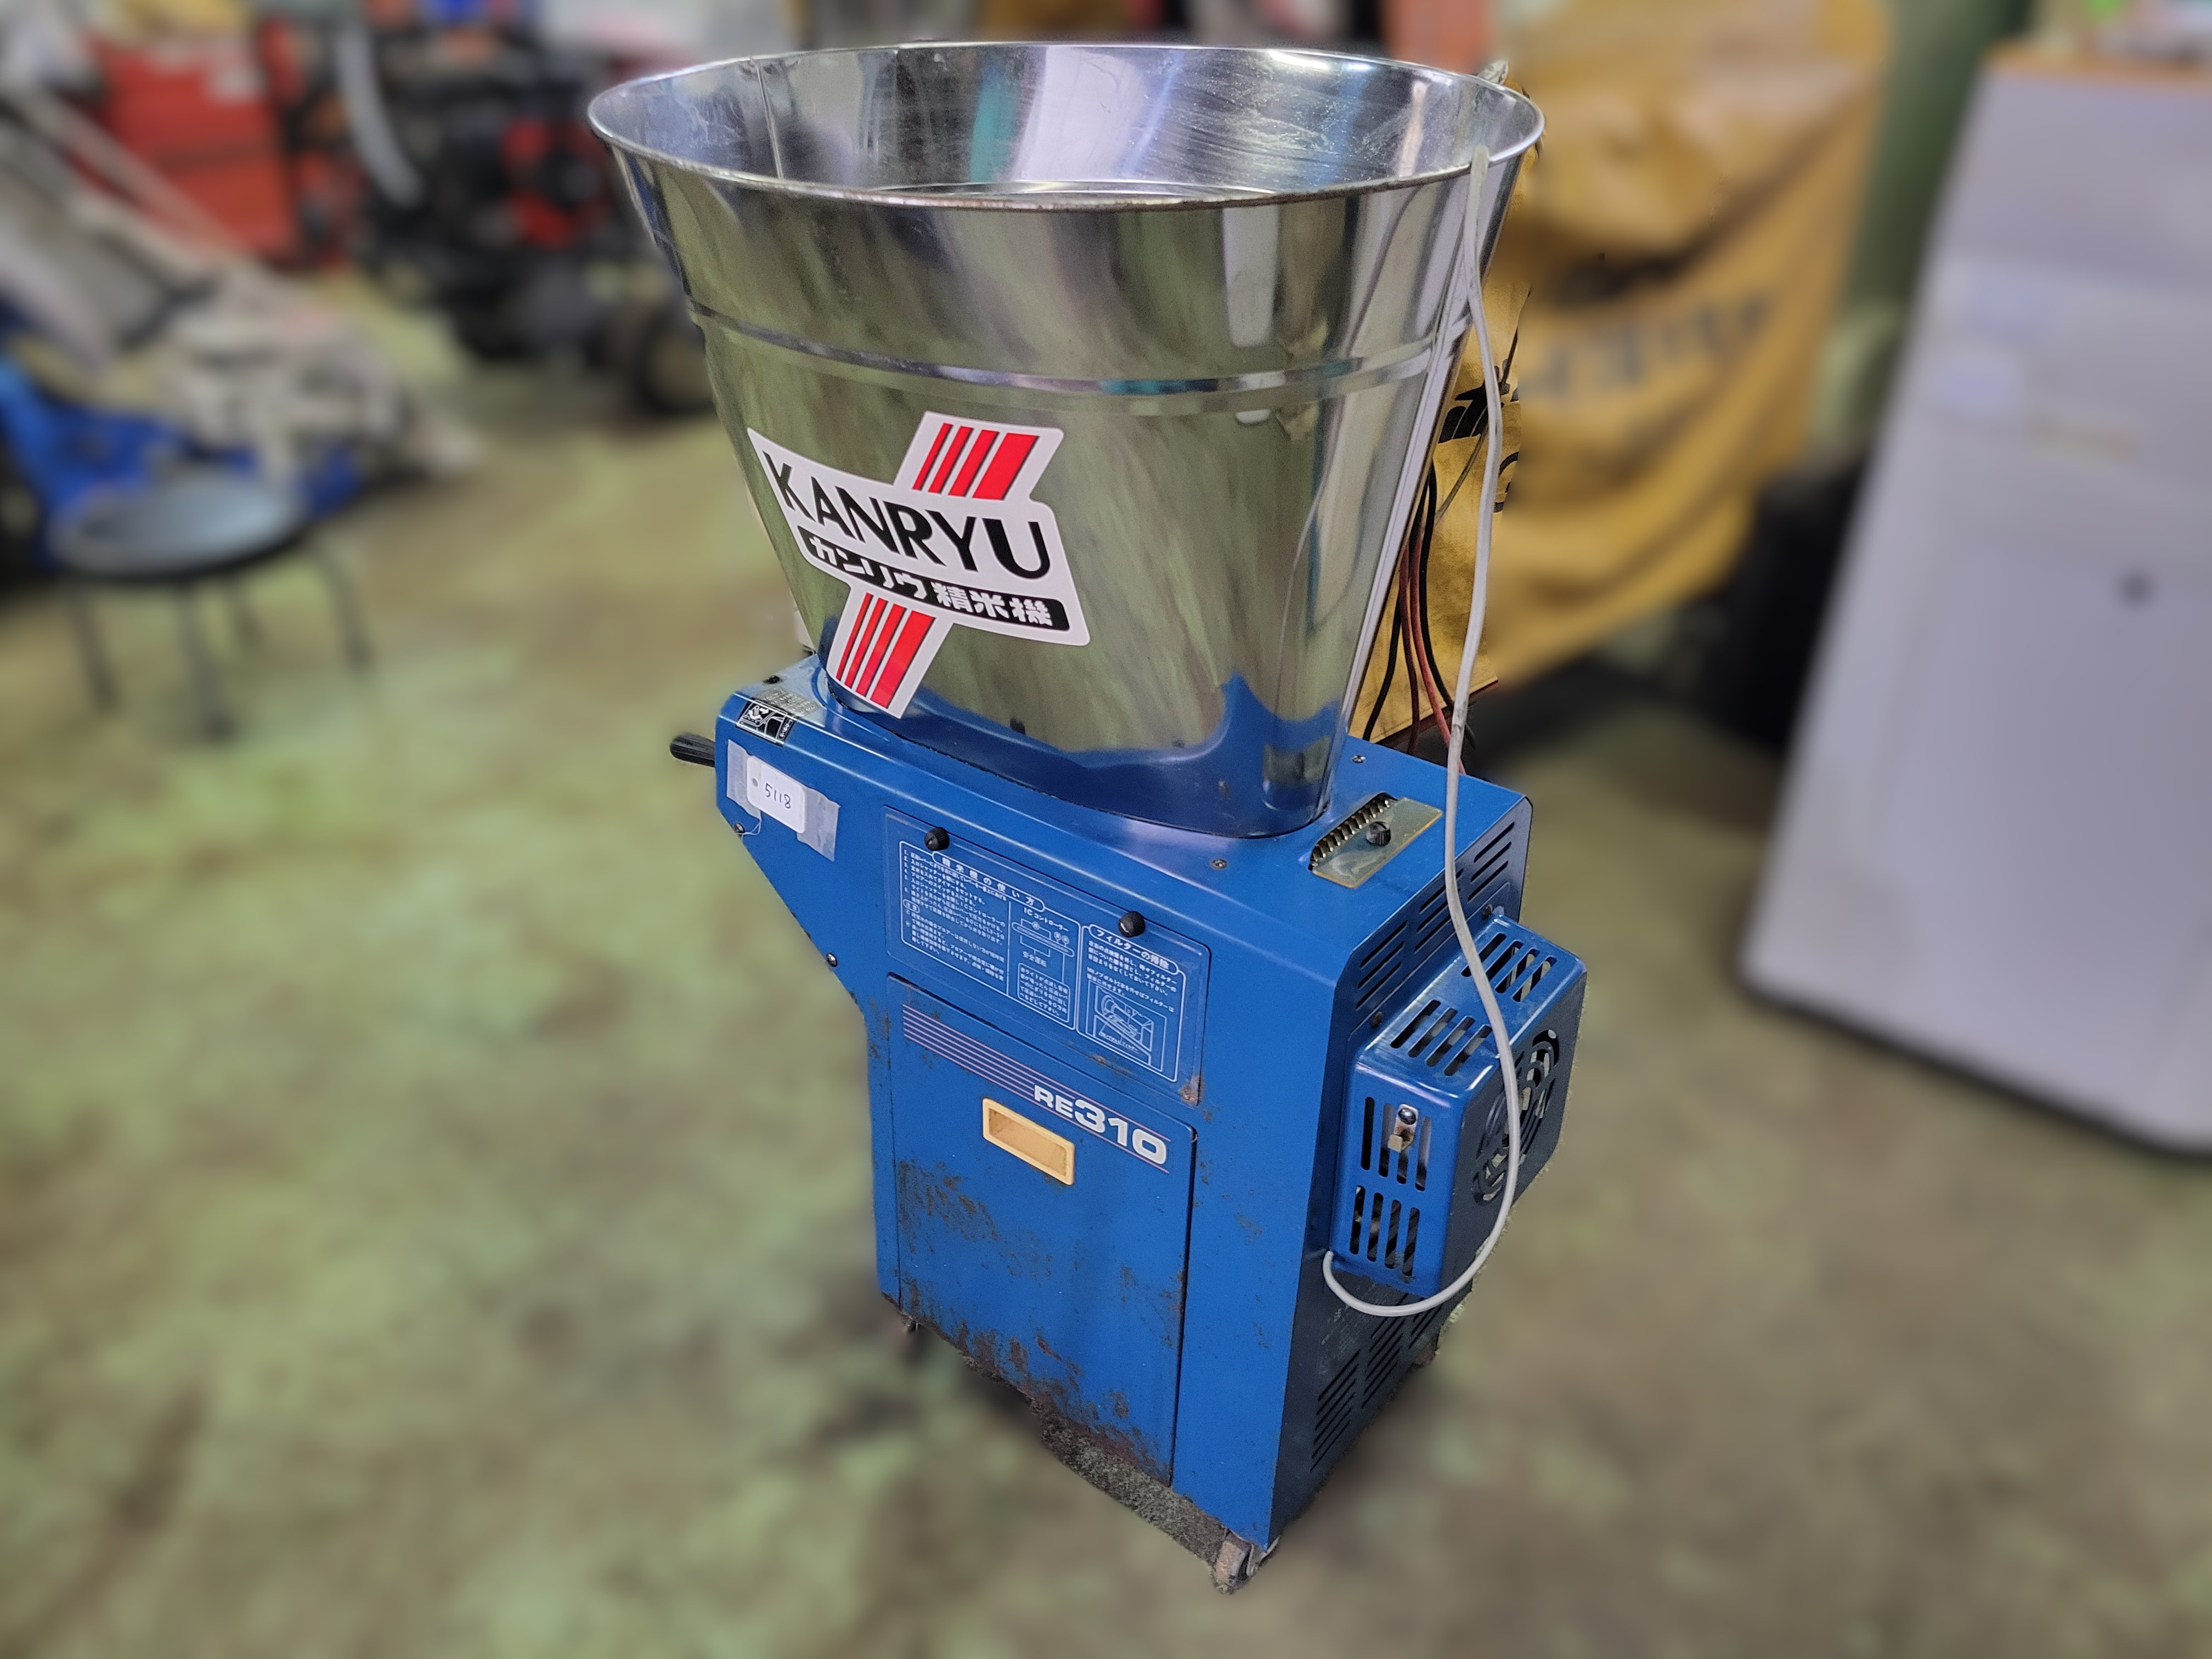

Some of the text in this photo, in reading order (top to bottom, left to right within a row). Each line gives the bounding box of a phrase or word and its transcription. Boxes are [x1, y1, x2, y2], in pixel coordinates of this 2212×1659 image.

[763, 452, 1050, 579] KANRYU
[765, 783, 791, 809] 5118
[1035, 1085, 1166, 1164] RE310
